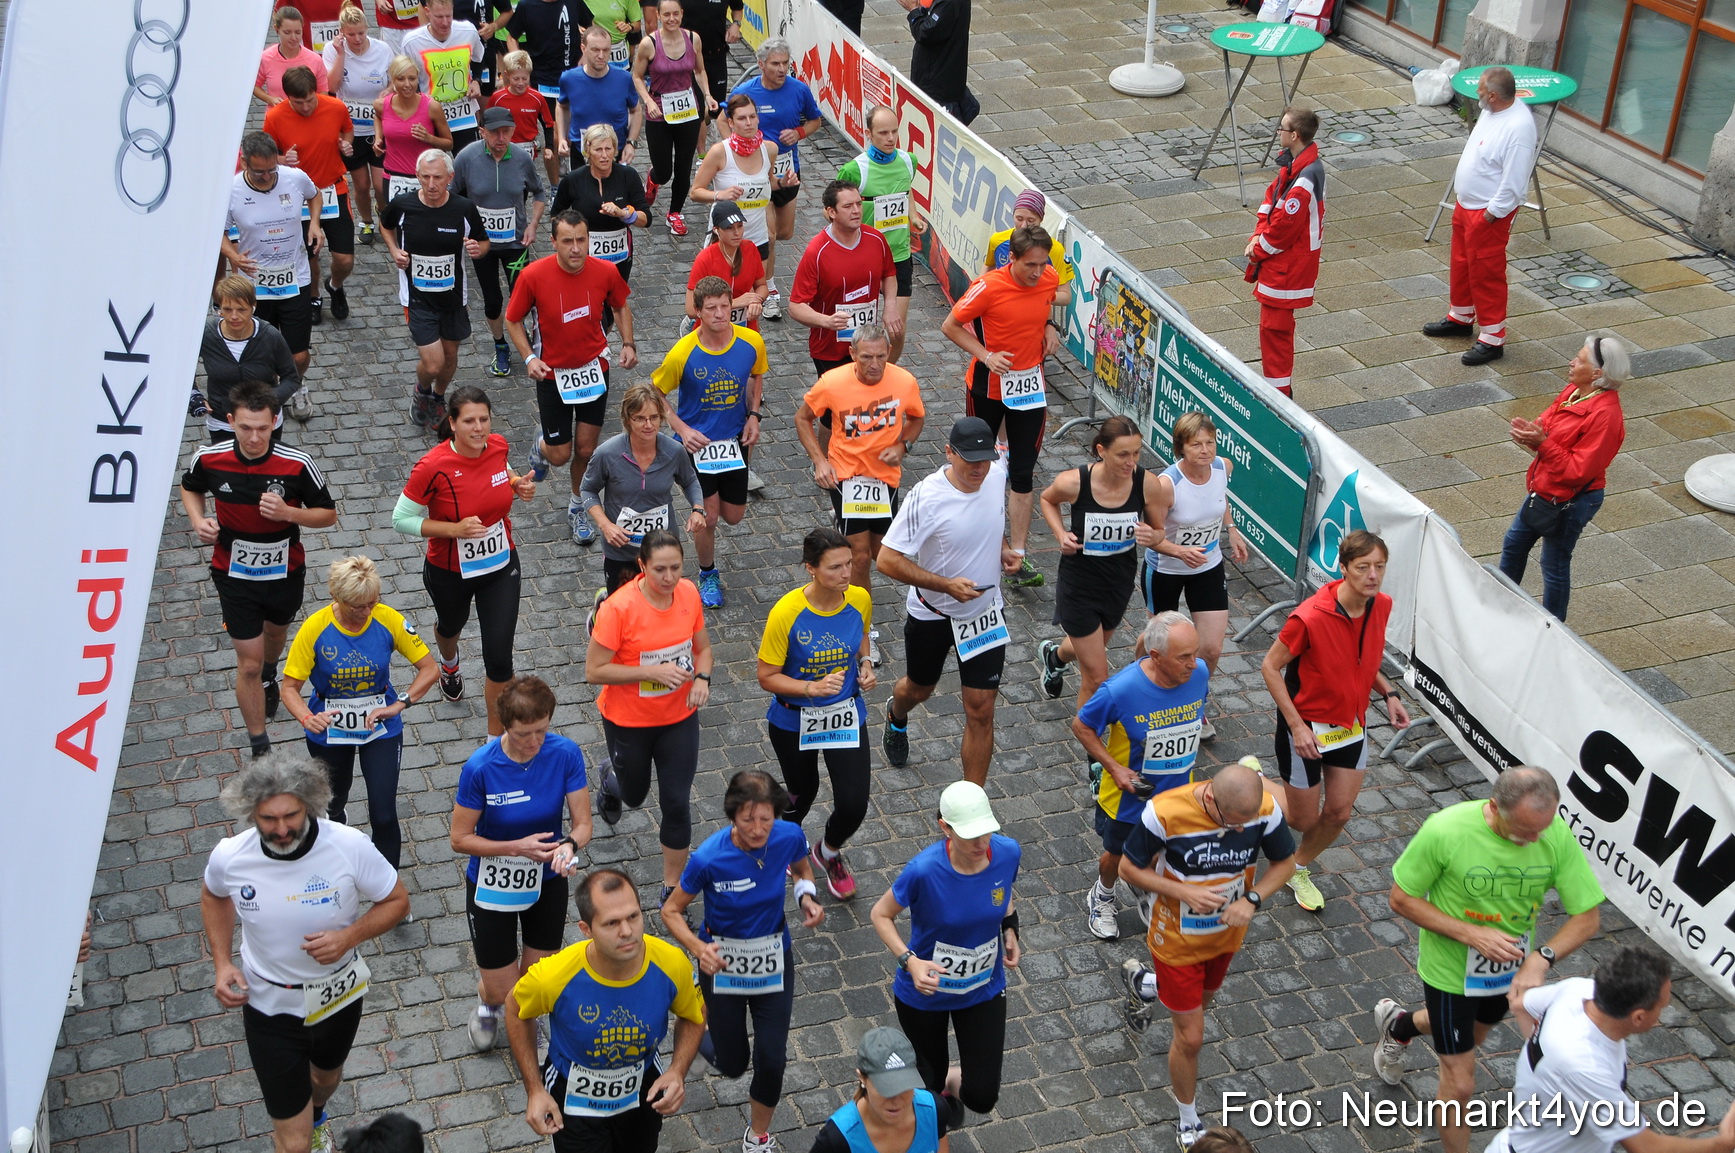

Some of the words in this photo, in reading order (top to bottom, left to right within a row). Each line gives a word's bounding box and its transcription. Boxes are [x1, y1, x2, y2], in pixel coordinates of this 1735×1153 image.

[432, 58, 462, 72] heute
[436, 69, 464, 93] 40
[670, 98, 690, 112] 194
[936, 124, 1018, 232] Egne
[746, 188, 764, 199] 27
[882, 201, 904, 218] 124
[480, 216, 512, 230] 2307
[882, 218, 904, 228] Christian
[932, 196, 980, 276] PFLASTER
[593, 238, 624, 254] 2694
[258, 272, 294, 286] 2260
[416, 264, 451, 278] 2458
[846, 309, 874, 328] 194
[561, 368, 599, 390] 2656
[1006, 376, 1040, 396] 2493
[1182, 353, 1251, 420] Event-Leit-Systeme
[88, 298, 156, 504] BKK
[1012, 396, 1034, 406] Andreas
[1160, 375, 1192, 412] Mehr
[1158, 400, 1176, 429] für
[700, 444, 737, 461] 2024
[1156, 435, 1172, 458] Miet
[710, 462, 730, 470] Stefan
[853, 484, 880, 501] 270
[854, 504, 878, 512] Günther
[622, 516, 664, 533] 2258
[1090, 526, 1134, 541] 2019
[1246, 520, 1265, 546] 6352
[1182, 526, 1220, 546] 2277
[464, 532, 504, 560] 3407
[236, 550, 284, 566] 2734
[245, 568, 272, 576] Markus
[958, 610, 998, 640] 2109
[966, 633, 998, 650] Wolfgang
[56, 548, 128, 773] Audi
[349, 700, 376, 708] Neumarkt
[1414, 668, 1457, 718] istungen,
[1457, 712, 1470, 734] die
[332, 710, 385, 730] 201
[1134, 714, 1149, 724] 10.
[1149, 699, 1202, 720] NEUMARKTER
[1148, 711, 1198, 730] STADTLAUF
[806, 710, 854, 733] 2108
[807, 732, 852, 742] Anna-Maria
[1168, 727, 1194, 738] Neumarkt
[1152, 734, 1197, 758] 2807
[1164, 760, 1182, 769] Gerd
[1566, 730, 1735, 934] SW
[484, 864, 538, 890] 3398
[1558, 804, 1706, 950] stadtwerke
[740, 946, 772, 954] Neumarkt
[722, 953, 778, 974] 2325
[940, 953, 992, 977] 2412
[320, 969, 358, 1006] 337
[730, 978, 768, 986] Gabriele
[574, 1076, 638, 1098] 2869
[588, 1100, 620, 1108] Martin
